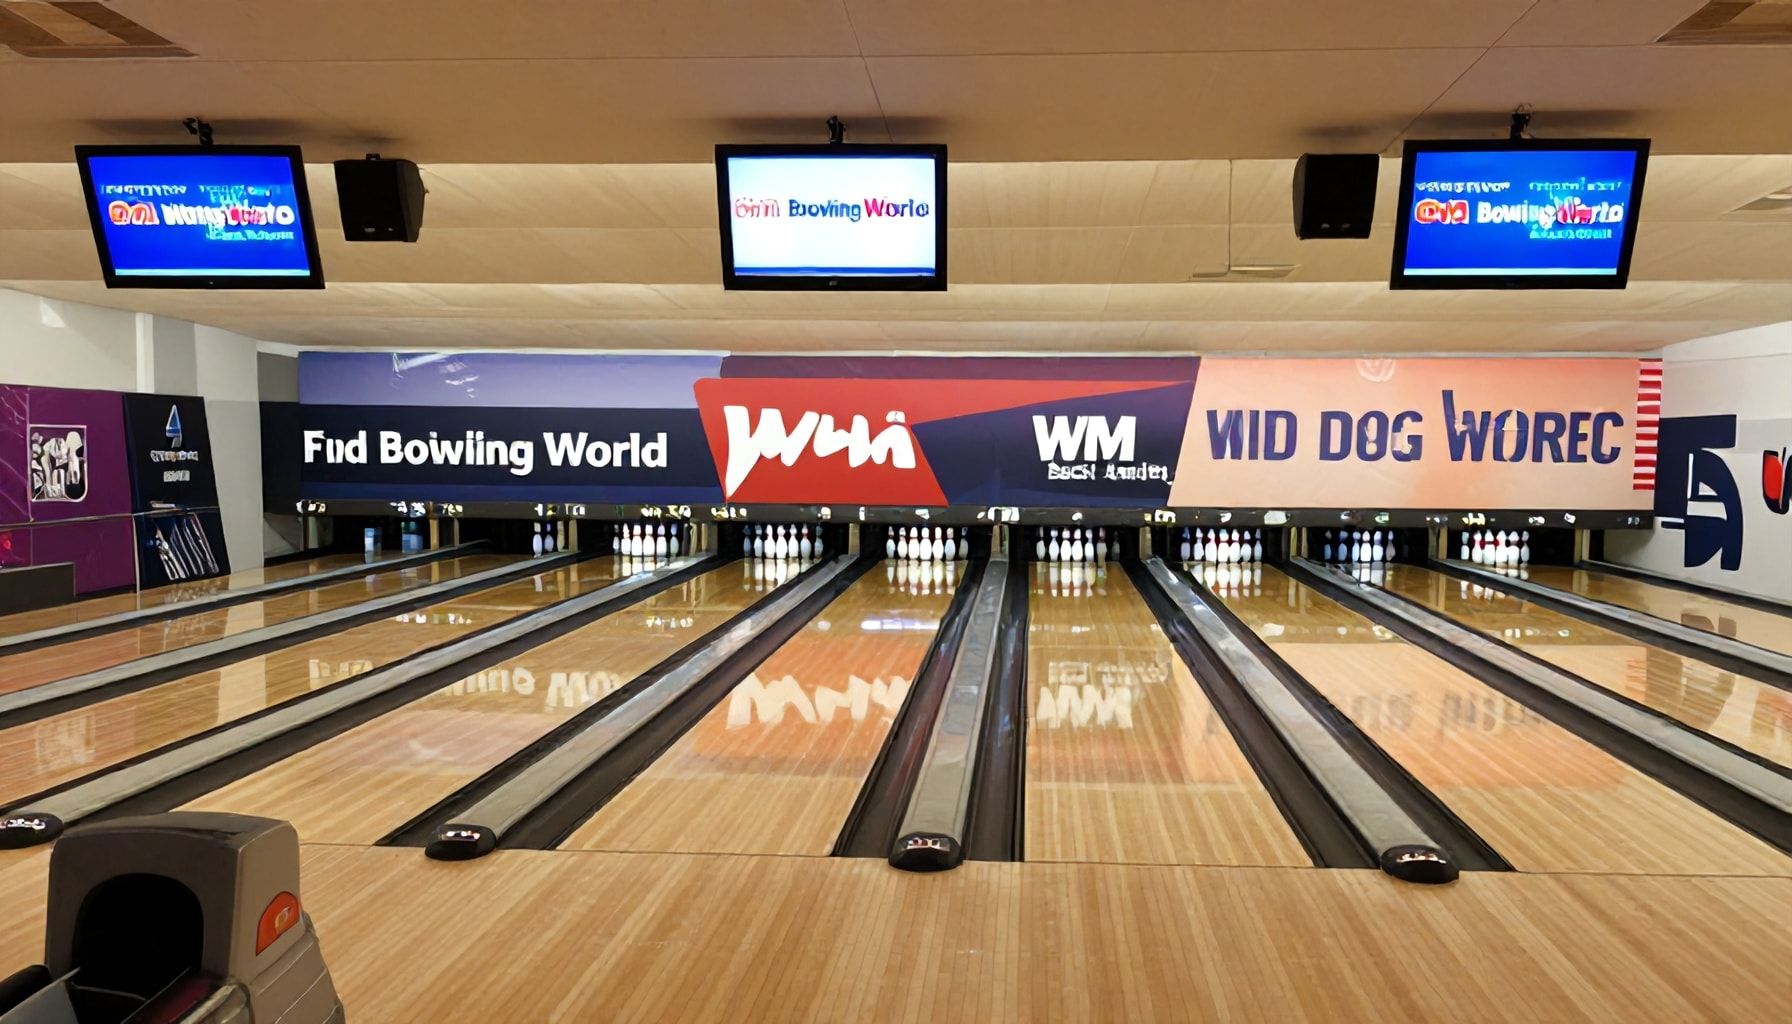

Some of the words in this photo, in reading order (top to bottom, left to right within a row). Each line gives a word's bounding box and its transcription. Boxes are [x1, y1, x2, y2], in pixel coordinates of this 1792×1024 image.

[542, 431, 668, 468] World
[1032, 415, 1136, 461] WM
[1319, 410, 1423, 462] DOG
